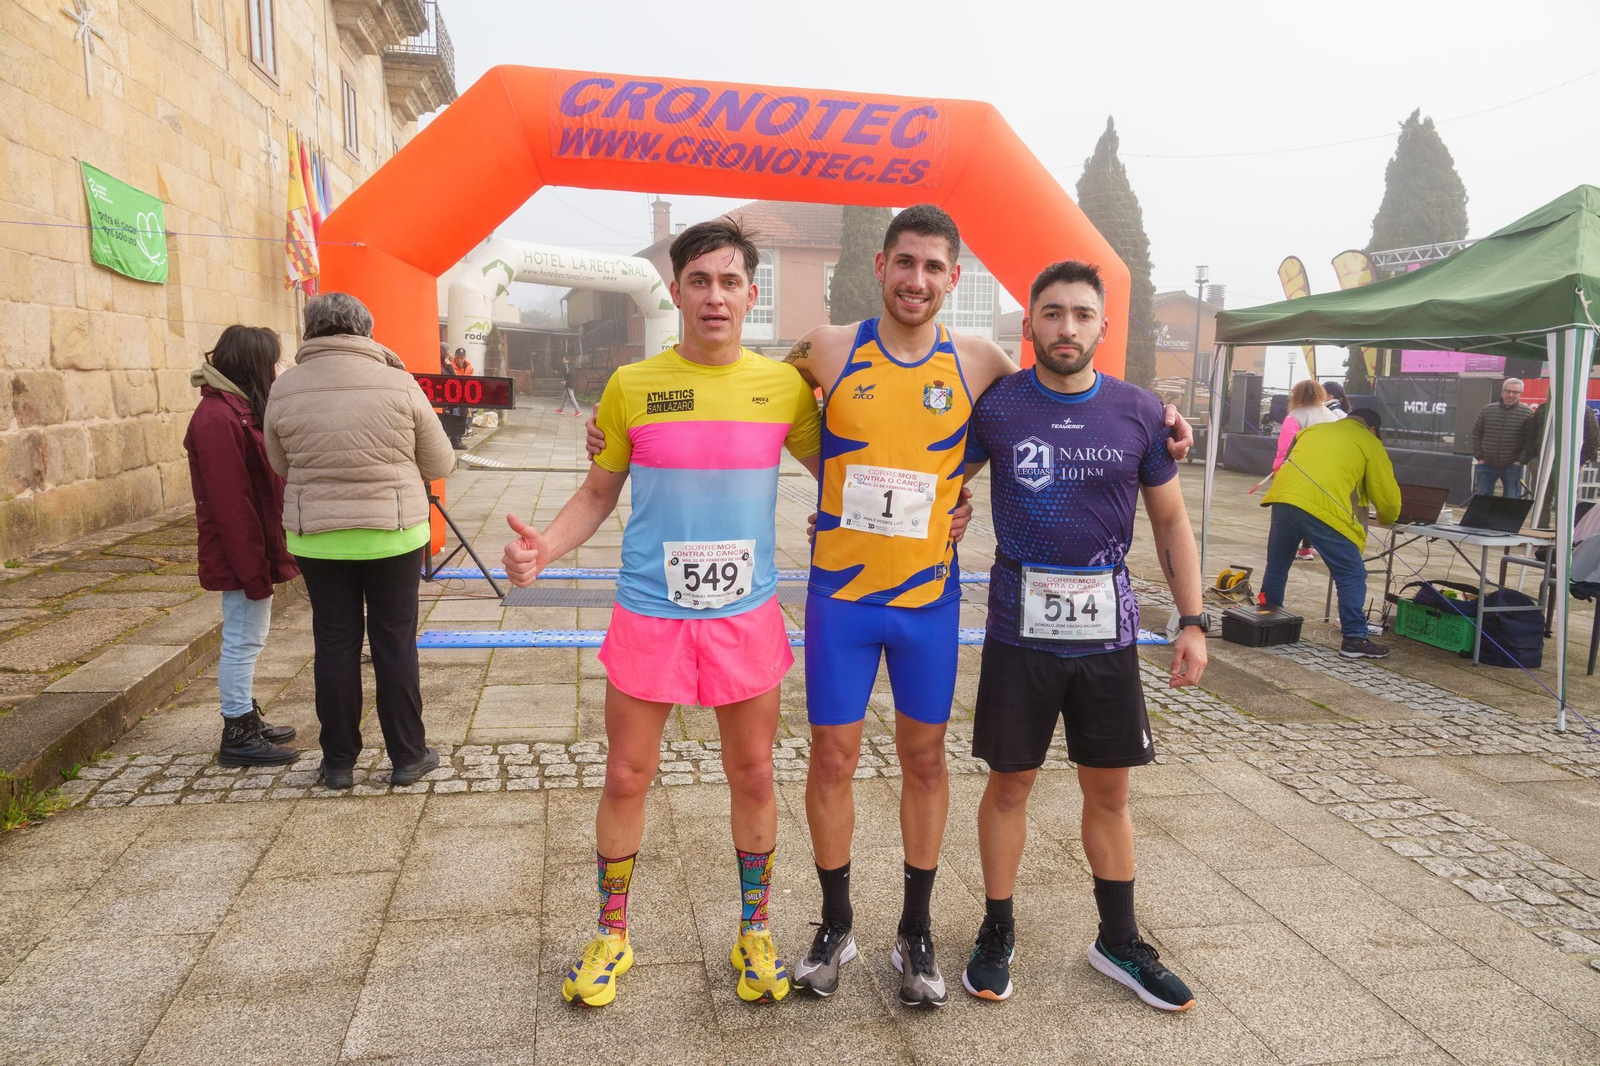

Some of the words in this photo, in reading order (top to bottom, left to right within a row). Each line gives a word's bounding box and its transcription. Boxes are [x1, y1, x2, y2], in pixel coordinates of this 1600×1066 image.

[559, 78, 939, 149] CRONOTEC
[558, 128, 931, 185] WWW.CRONOTEC.ES
[524, 250, 565, 268] HOTEL
[572, 257, 587, 271] LA
[522, 268, 595, 282] www.hotelrectoral.com
[647, 389, 694, 402] ATHLETICS
[648, 403, 662, 414] SAN
[1017, 442, 1050, 468] 21
[1059, 445, 1124, 462] NARÓN
[868, 468, 918, 480] CORREMOS
[881, 489, 893, 518] 1
[685, 543, 737, 551] CORREMOS
[716, 549, 749, 557] CANCRO
[683, 562, 738, 592] 549
[1046, 576, 1096, 584] CORREMOS
[1032, 581, 1066, 589] CONTRA
[1044, 594, 1099, 622] 514
[744, 889, 765, 901] SMILE!
[605, 908, 624, 921] COOL!
